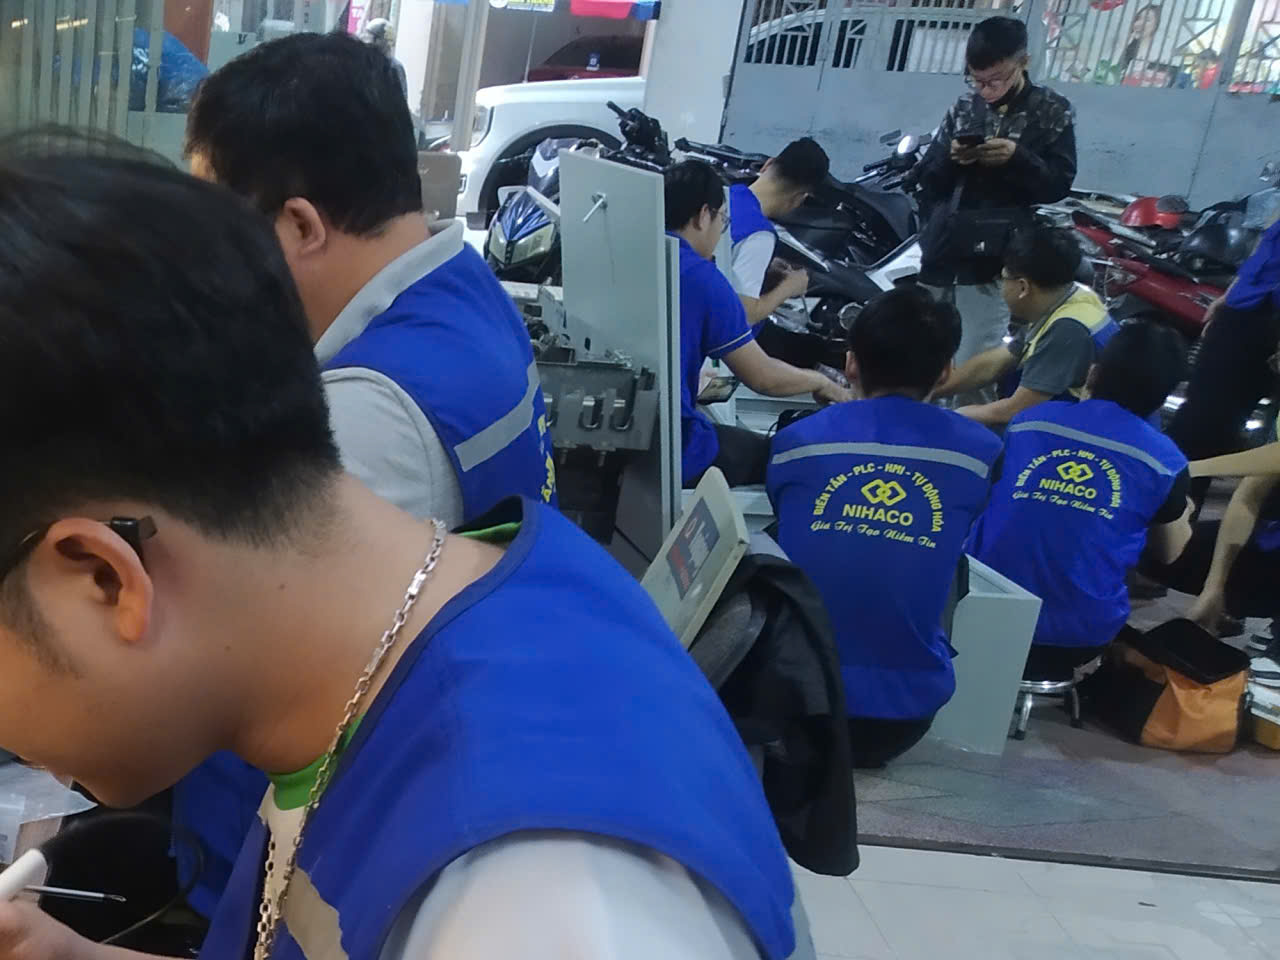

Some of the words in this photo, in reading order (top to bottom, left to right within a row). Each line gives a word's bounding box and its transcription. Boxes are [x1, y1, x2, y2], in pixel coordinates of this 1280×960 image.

[852, 463, 875, 475] PLC
[884, 463, 906, 475] HMI
[1039, 478, 1097, 499] NIHACO
[842, 504, 913, 526] NIHACO
